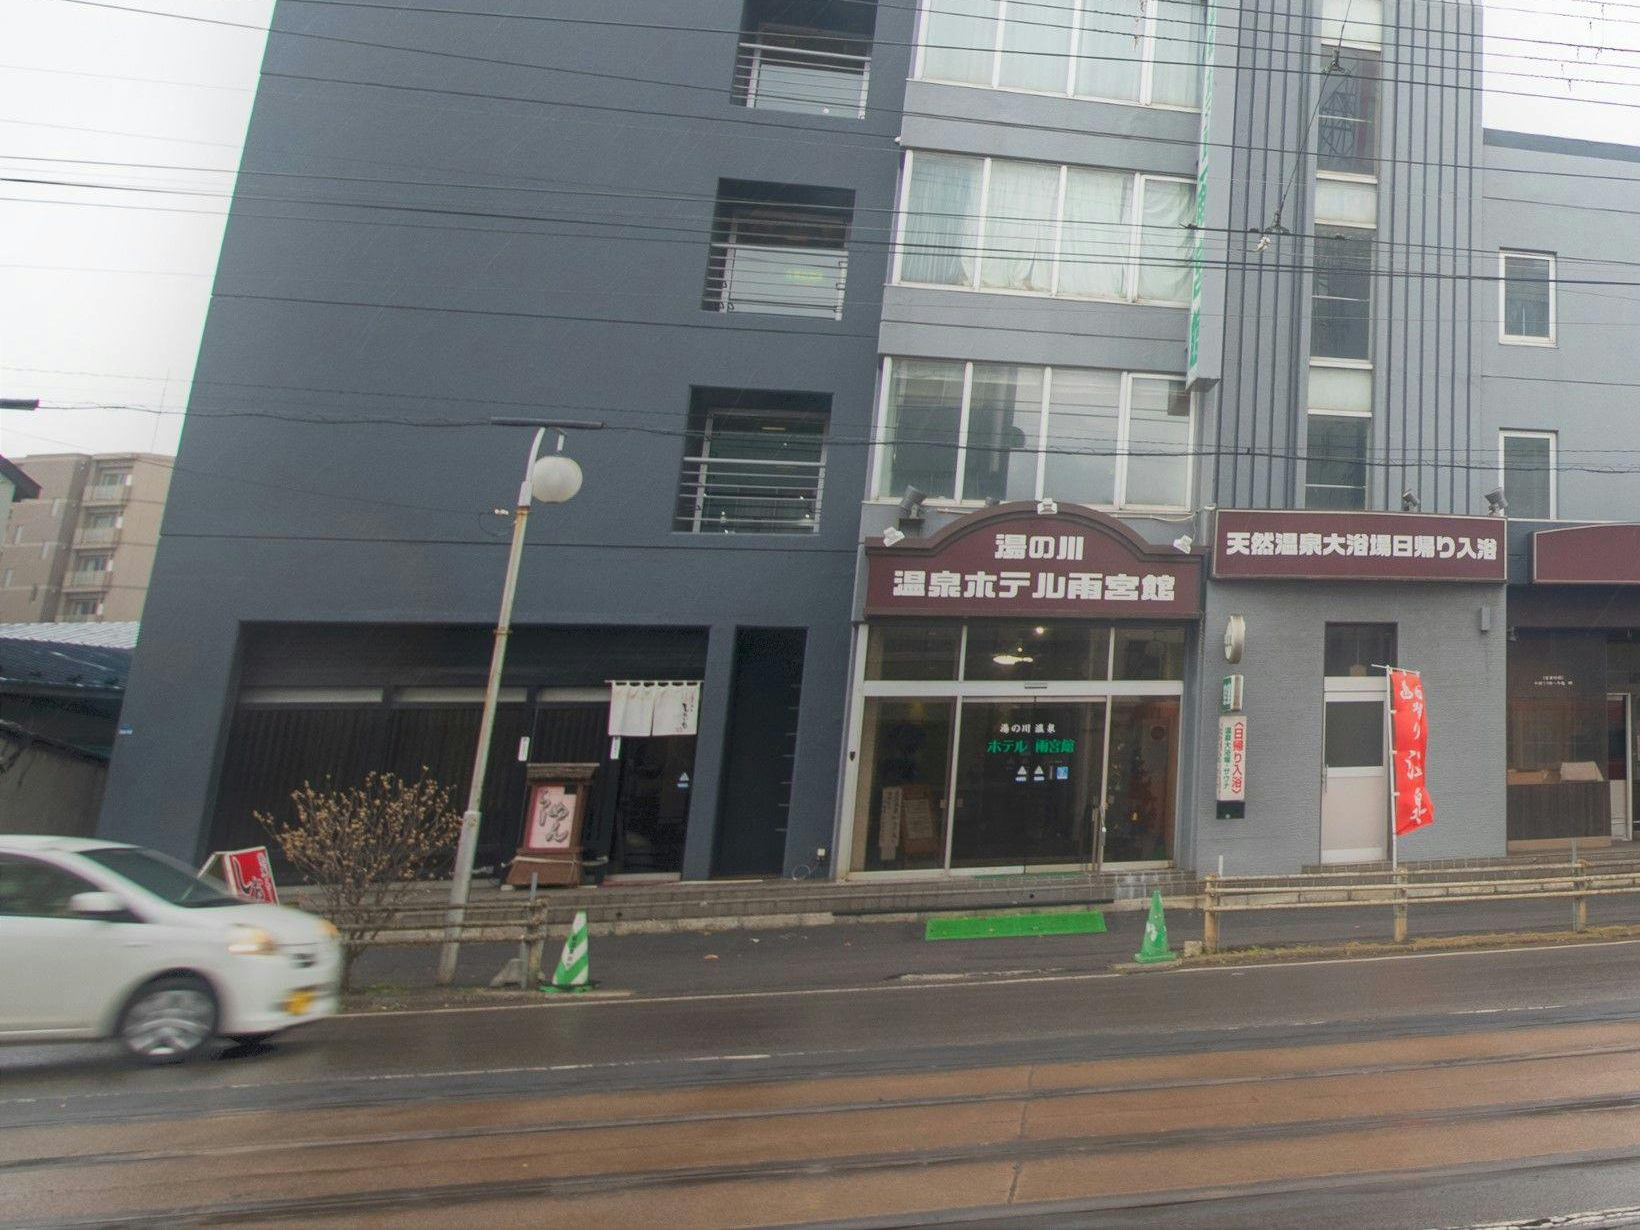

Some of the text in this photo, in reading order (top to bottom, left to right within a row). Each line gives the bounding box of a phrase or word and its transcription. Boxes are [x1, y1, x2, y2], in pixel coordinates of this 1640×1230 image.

[995, 532, 1085, 562] 湯の川
[1226, 531, 1498, 562] 天然温泉大浴場日帰り入浴
[892, 569, 1176, 602] 温泉ホテル雨宮館
